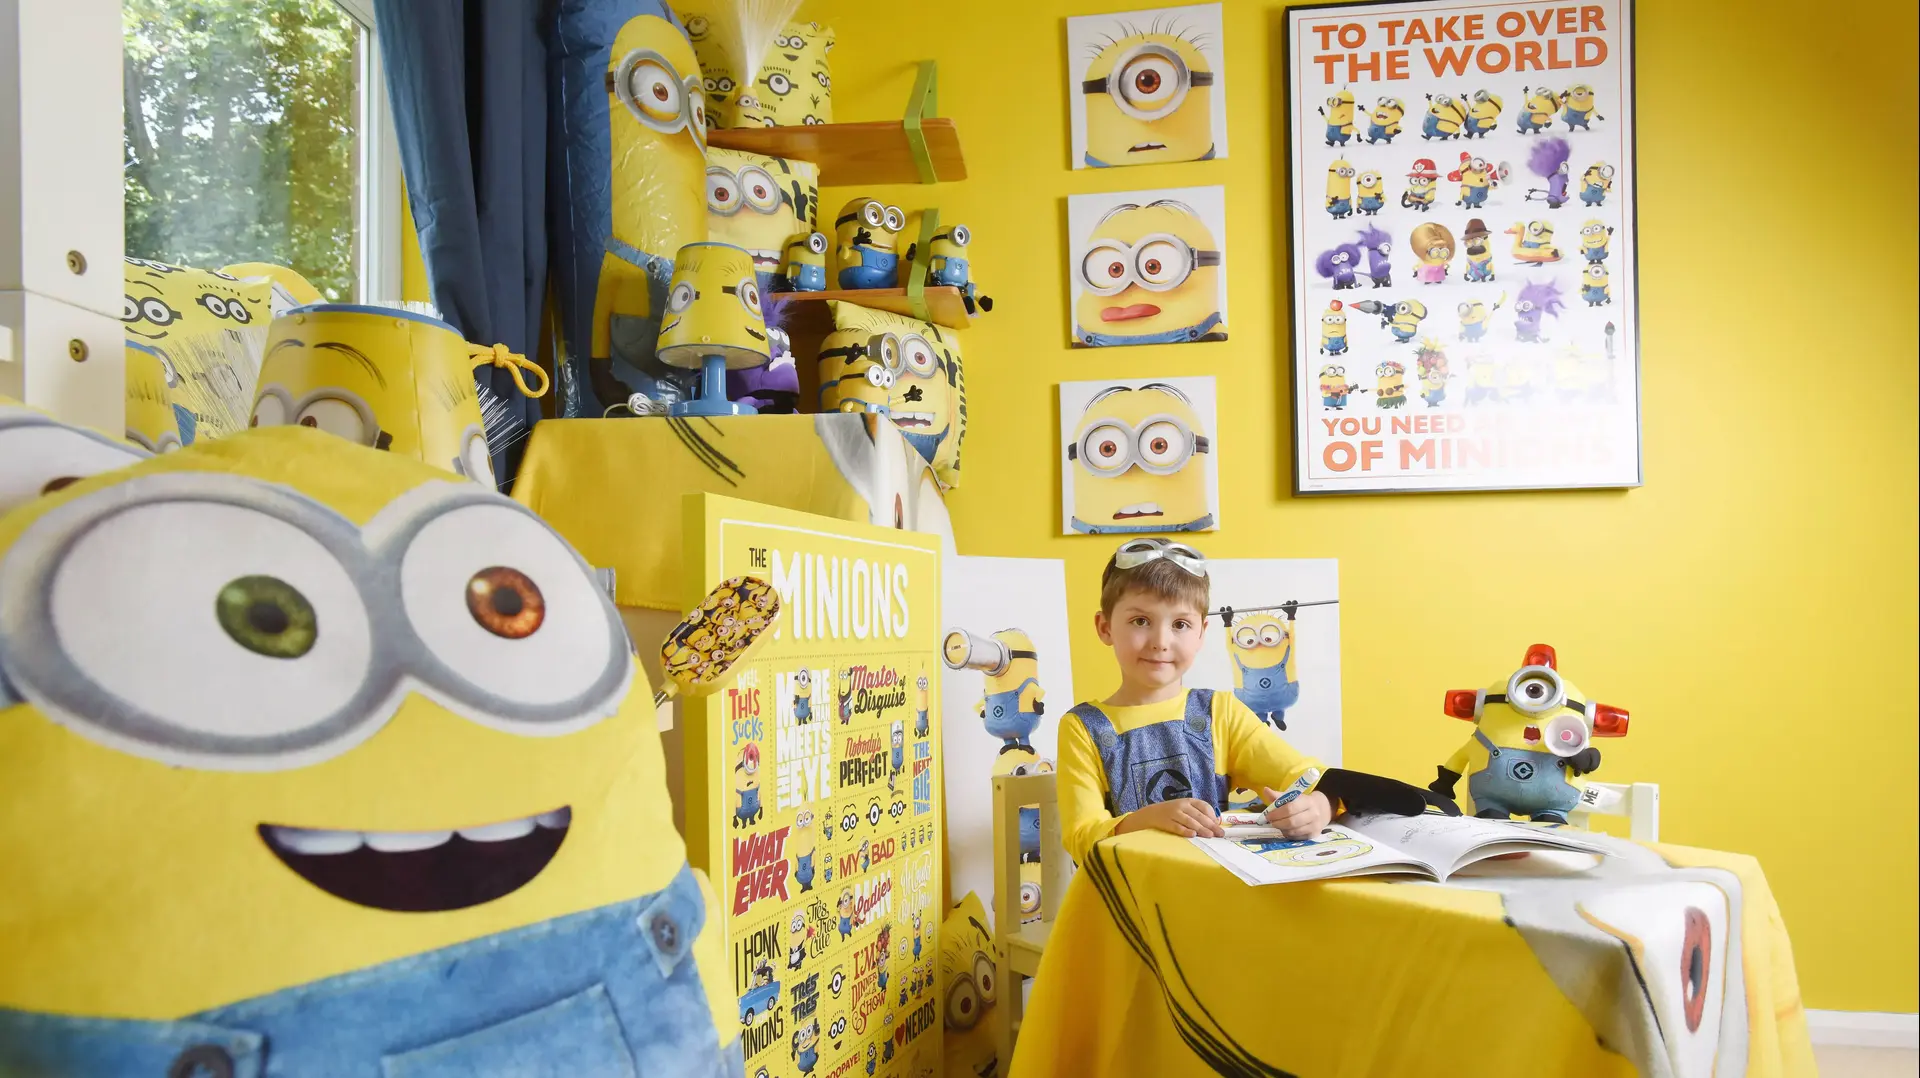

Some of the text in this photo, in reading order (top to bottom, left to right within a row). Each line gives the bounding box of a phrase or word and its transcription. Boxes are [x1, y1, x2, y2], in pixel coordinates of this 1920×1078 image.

[1312, 5, 1607, 50] TO TAKE OVER
[1313, 36, 1608, 84] THE WORLD
[1321, 416, 1381, 436] YOU
[1391, 413, 1465, 435] NEED
[1322, 440, 1383, 472] OF
[749, 548, 909, 640] THE MINIONS
[852, 664, 906, 691] Master of
[728, 688, 760, 721] THIS
[854, 687, 907, 718] Disguise
[776, 721, 831, 763] MEETS
[845, 733, 882, 762] Nobody's
[913, 741, 930, 760] THE
[790, 753, 831, 809] EYE
[840, 751, 888, 788] PERFECT
[913, 758, 931, 777] NEXT
[913, 768, 930, 801] BIG
[913, 801, 931, 817] THING
[733, 826, 791, 878] WHAT
[840, 837, 895, 879] MY BAD
[732, 859, 790, 917] EVER
[853, 878, 892, 925] Ladies
[735, 921, 782, 996] I HONK
[853, 942, 876, 980] I'M
[852, 971, 877, 1012] DINNER
[904, 997, 935, 1045] NERDS
